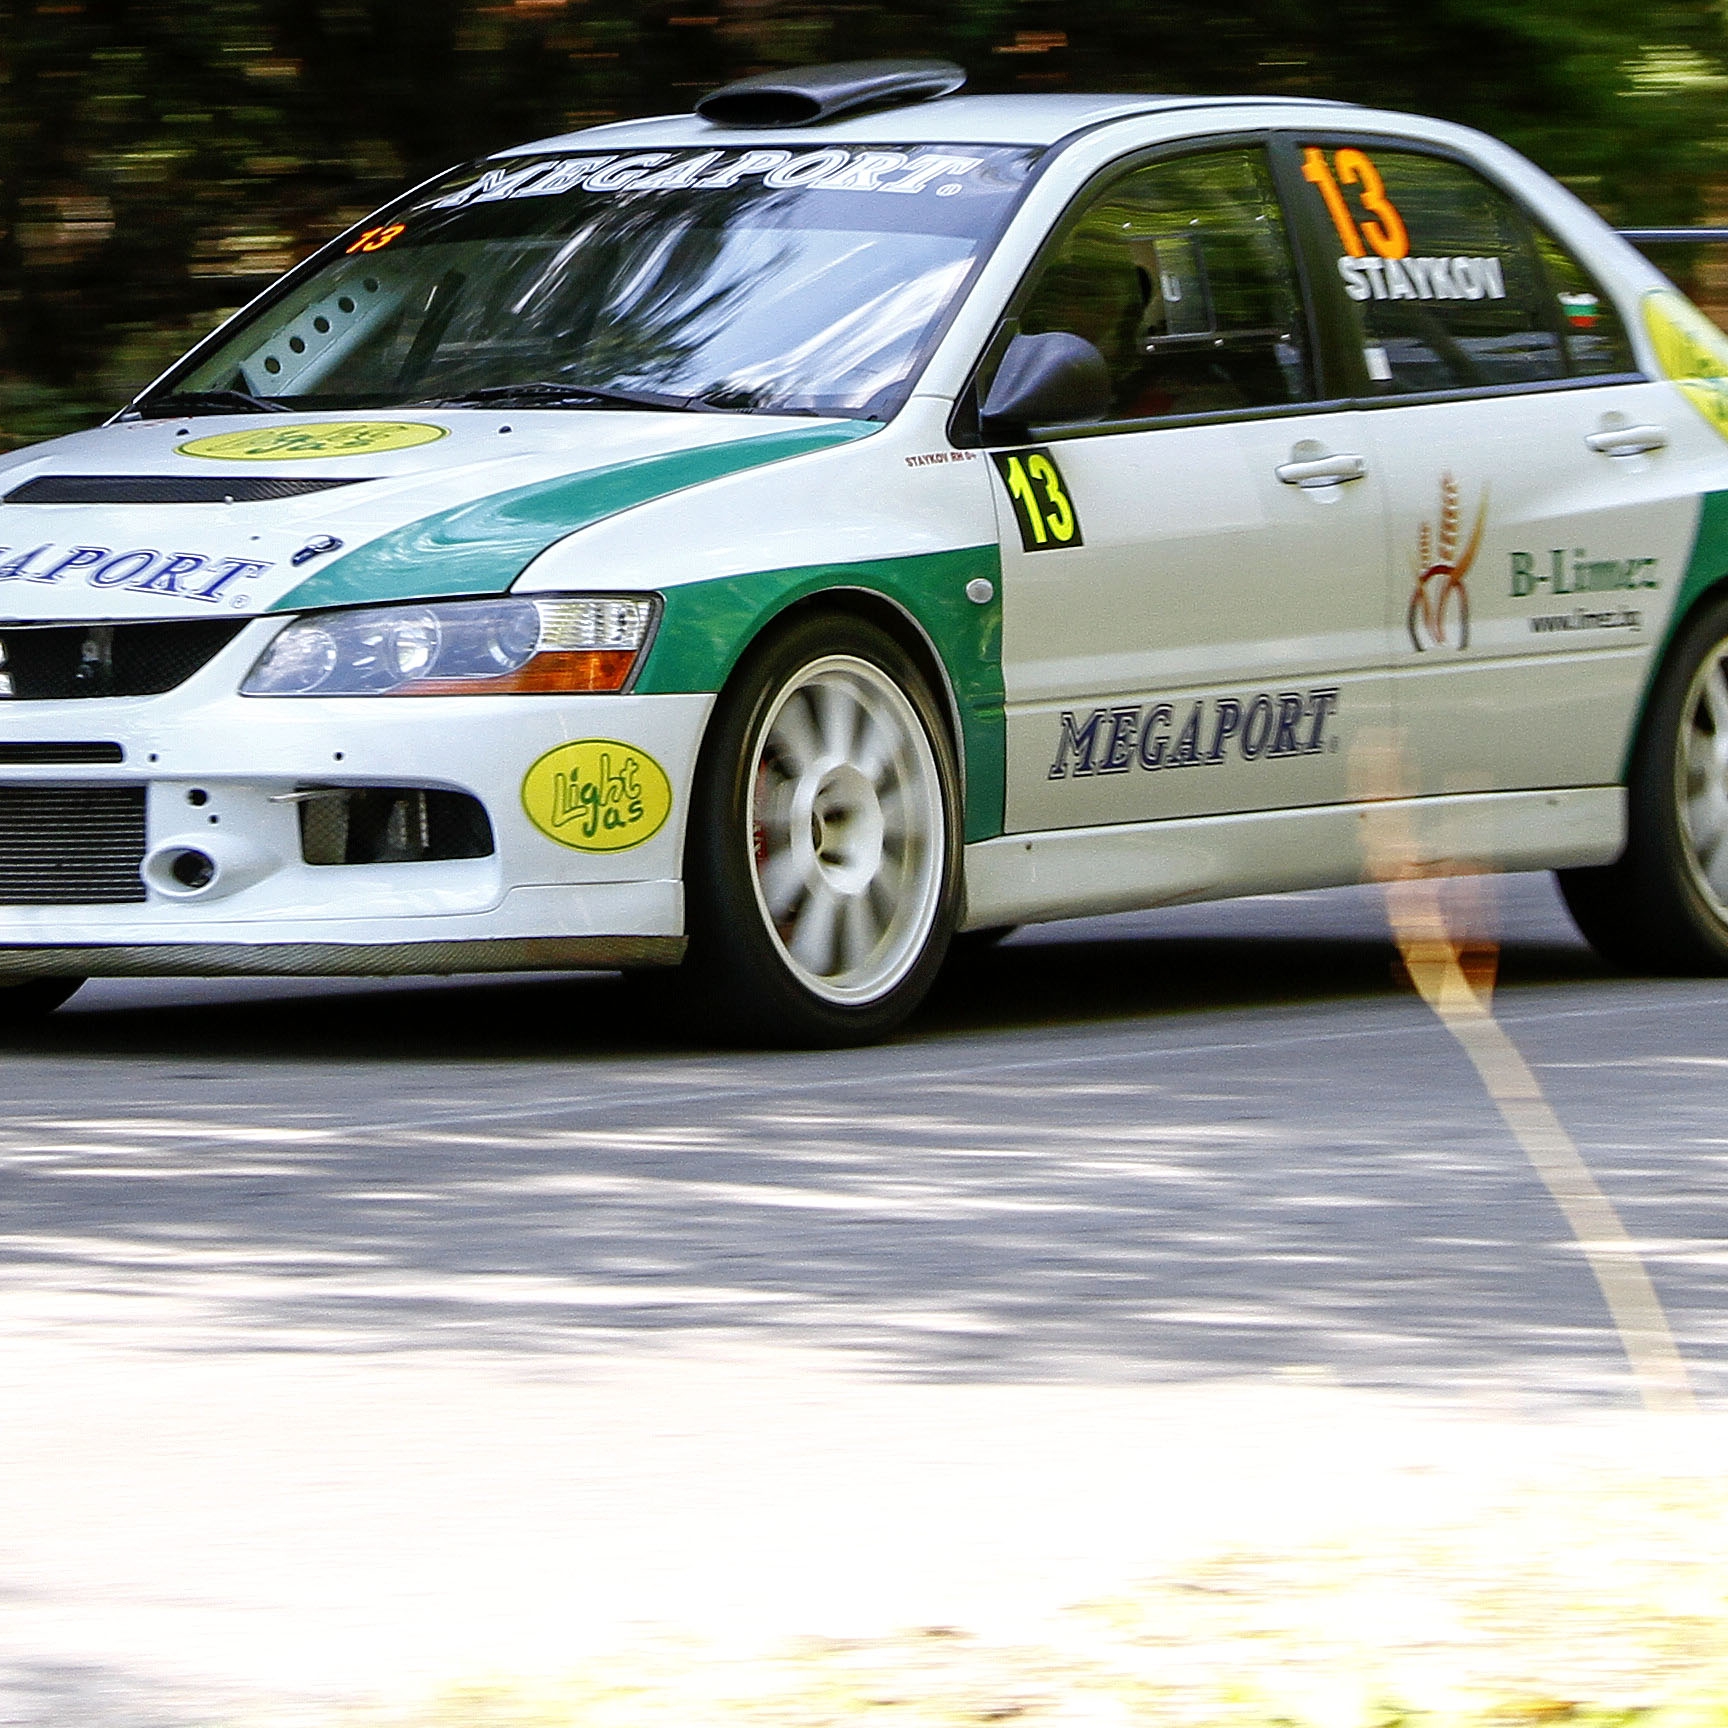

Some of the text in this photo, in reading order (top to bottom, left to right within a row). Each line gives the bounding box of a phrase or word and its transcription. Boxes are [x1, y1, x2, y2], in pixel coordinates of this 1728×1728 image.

[434, 149, 983, 208] MEGAPORT
[1302, 146, 1410, 260] 13
[346, 223, 406, 254] 13
[1338, 256, 1506, 301] STAYKOV
[904, 452, 949, 467] STAYKOV
[950, 452, 964, 462] RH
[1008, 454, 1075, 544] 13
[1047, 687, 1340, 780] MEGAPORT
[552, 753, 642, 838] Light
